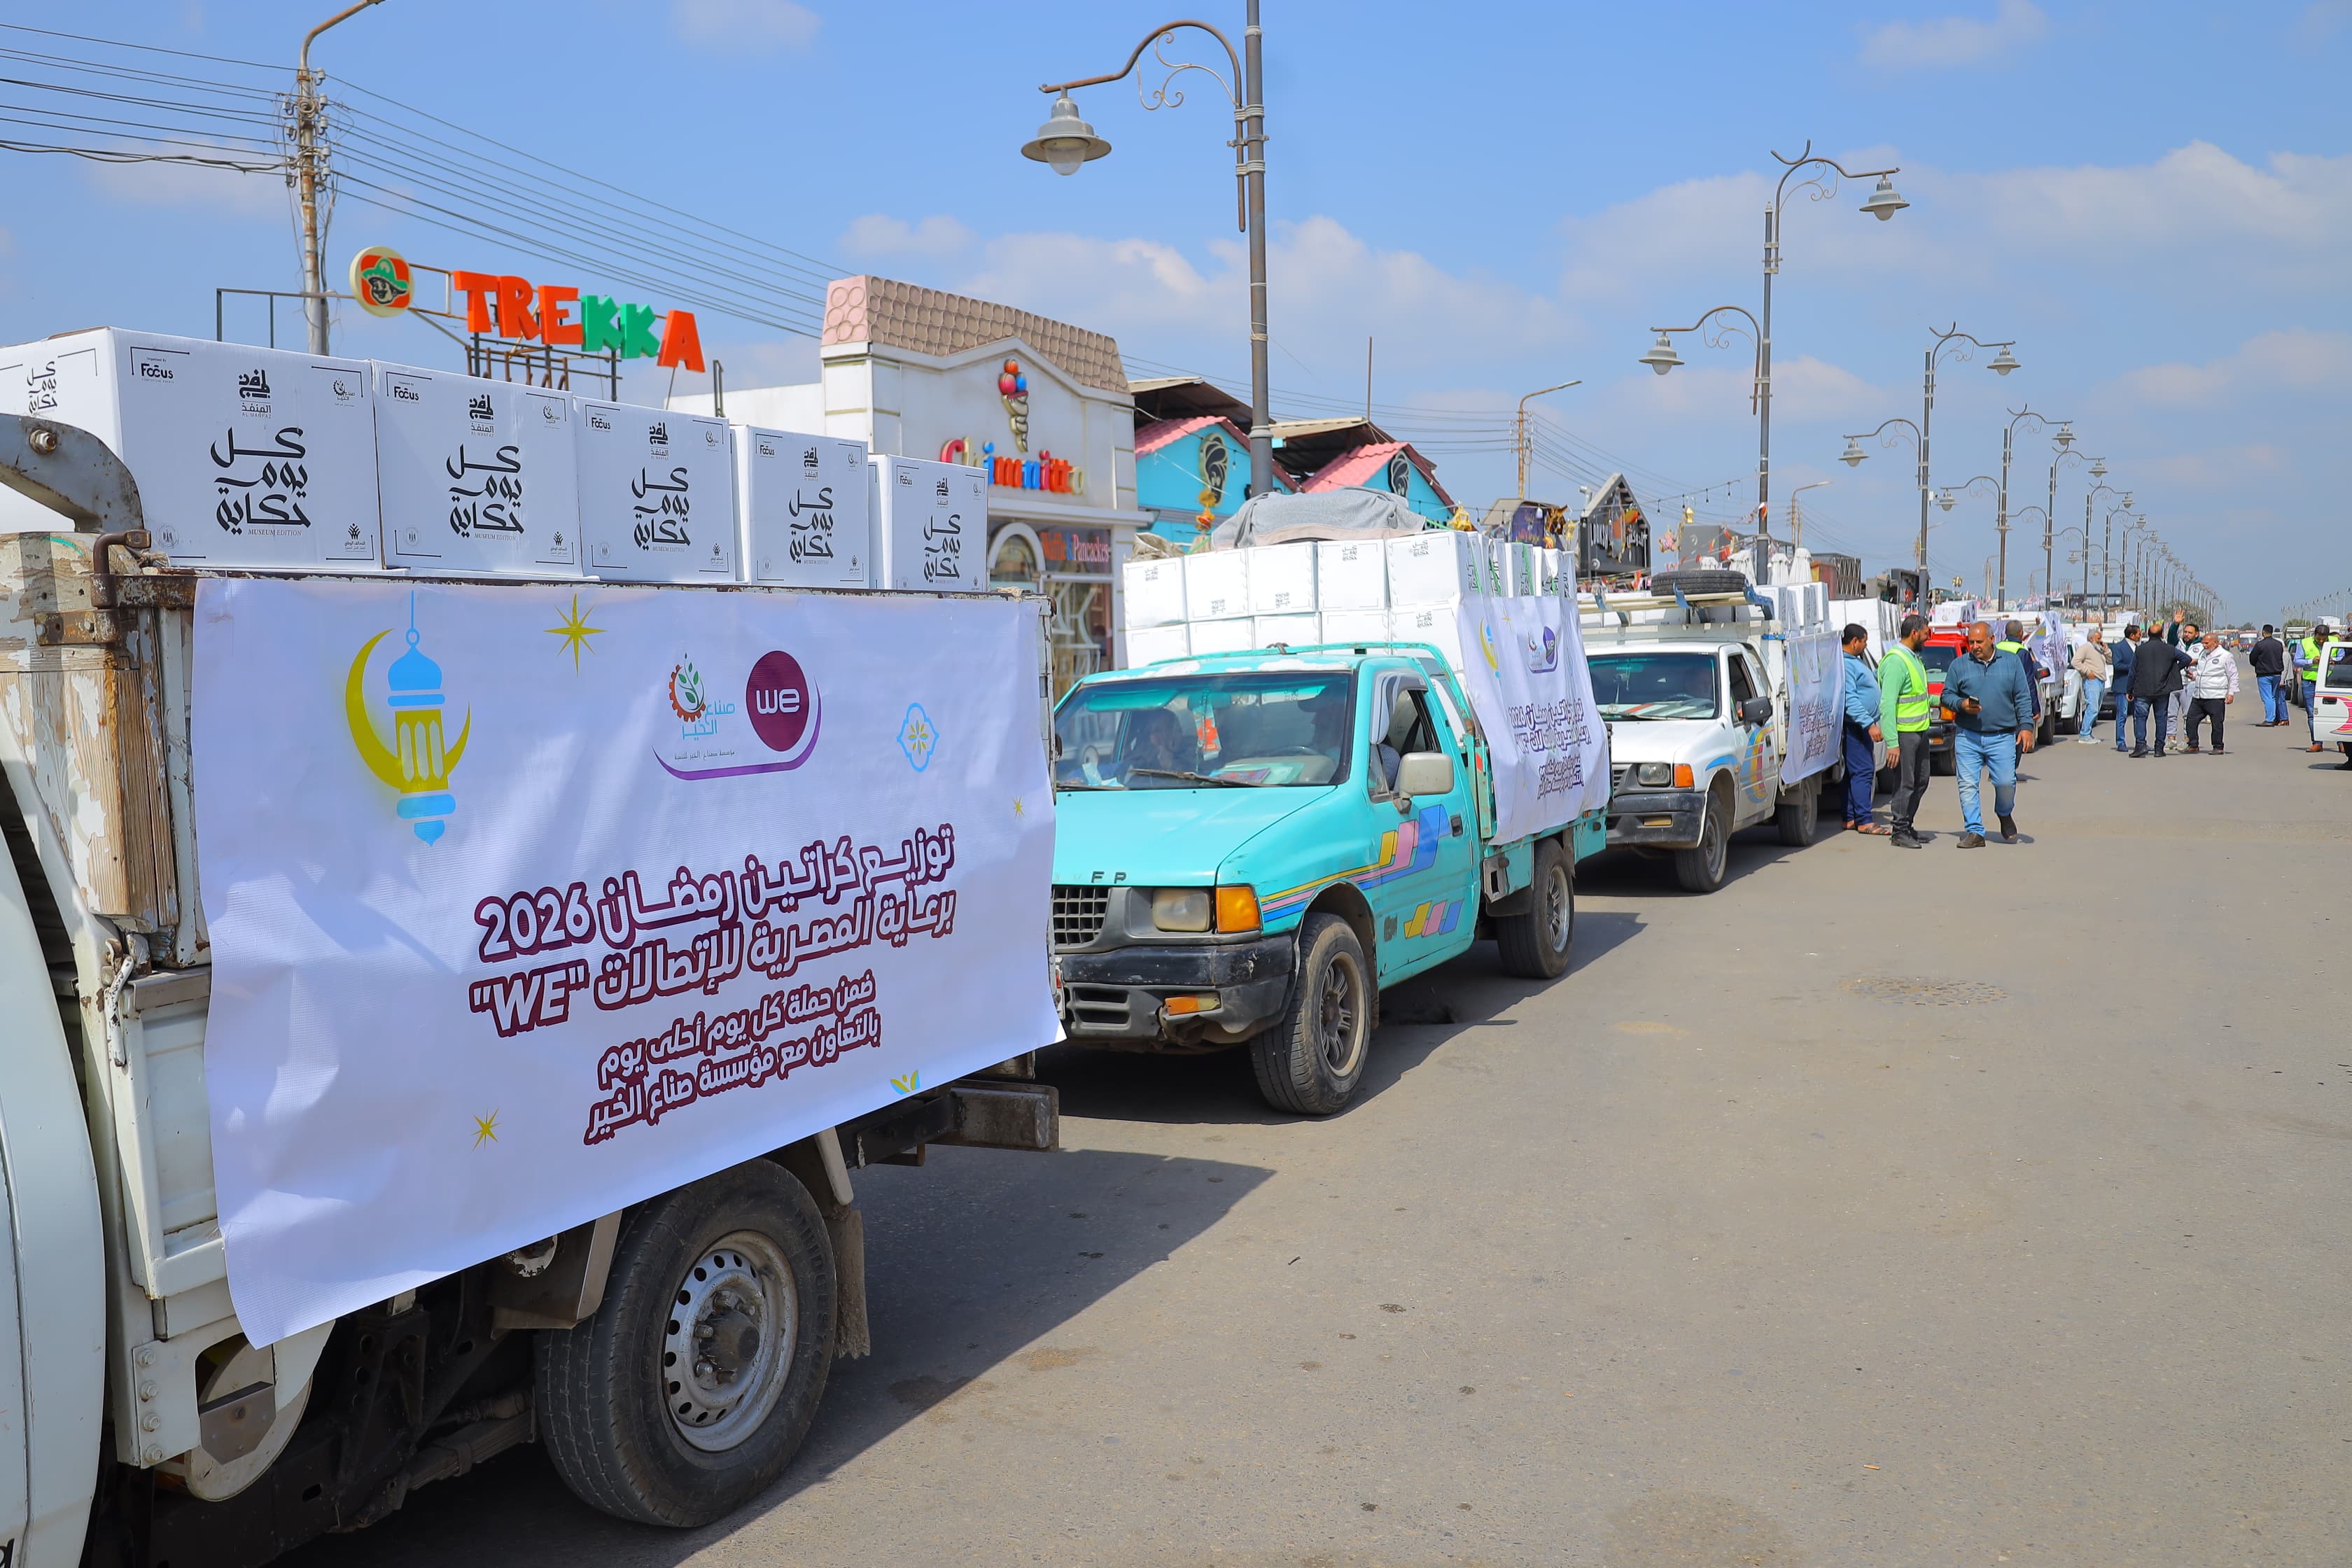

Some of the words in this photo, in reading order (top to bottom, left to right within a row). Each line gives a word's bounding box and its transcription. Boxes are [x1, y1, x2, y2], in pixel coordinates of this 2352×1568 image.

[454, 270, 706, 373] TREKKA
[27, 360, 56, 386] كل
[28, 378, 57, 393] يوم
[141, 363, 174, 379] Focus
[241, 402, 272, 414] المنفذ
[394, 386, 419, 401] Focus
[471, 423, 494, 433] المنفذ
[591, 417, 611, 430] Focus
[211, 426, 306, 468] كل
[447, 444, 521, 479] كل
[214, 461, 309, 498] يوم
[449, 475, 522, 508] يوم
[631, 466, 689, 499] كل
[216, 487, 312, 536] حكاية
[450, 496, 524, 538] حكاية
[634, 493, 690, 523] يوم
[789, 487, 833, 517] كل
[634, 513, 691, 551] حكاية
[790, 512, 834, 538] يوم
[923, 514, 961, 541] كل
[790, 531, 834, 564] حكاية
[924, 536, 960, 559] يوم
[923, 553, 960, 584] حكاية
[704, 700, 735, 725] صناع
[756, 688, 800, 714] we
[682, 719, 718, 741] الخير
[741, 836, 861, 920] كراتين
[860, 823, 955, 896] توزيع
[474, 881, 596, 963] 2026
[596, 866, 739, 949] رمضان
[876, 886, 957, 947] برعاية
[747, 895, 876, 979] المصرية
[594, 922, 744, 1011] للإتصالات
[785, 983, 835, 1024] حملة
[833, 969, 876, 1016] ضمن
[706, 1009, 751, 1056] يوم
[750, 990, 785, 1041] كل
[646, 1011, 706, 1065] أحلى
[809, 1007, 882, 1068] بالتعاون
[597, 1037, 650, 1091] يوم
[696, 1043, 778, 1097] مؤسسة
[777, 1037, 811, 1079] مع
[584, 1079, 648, 1145] الخير
[646, 1068, 698, 1126] صناع
